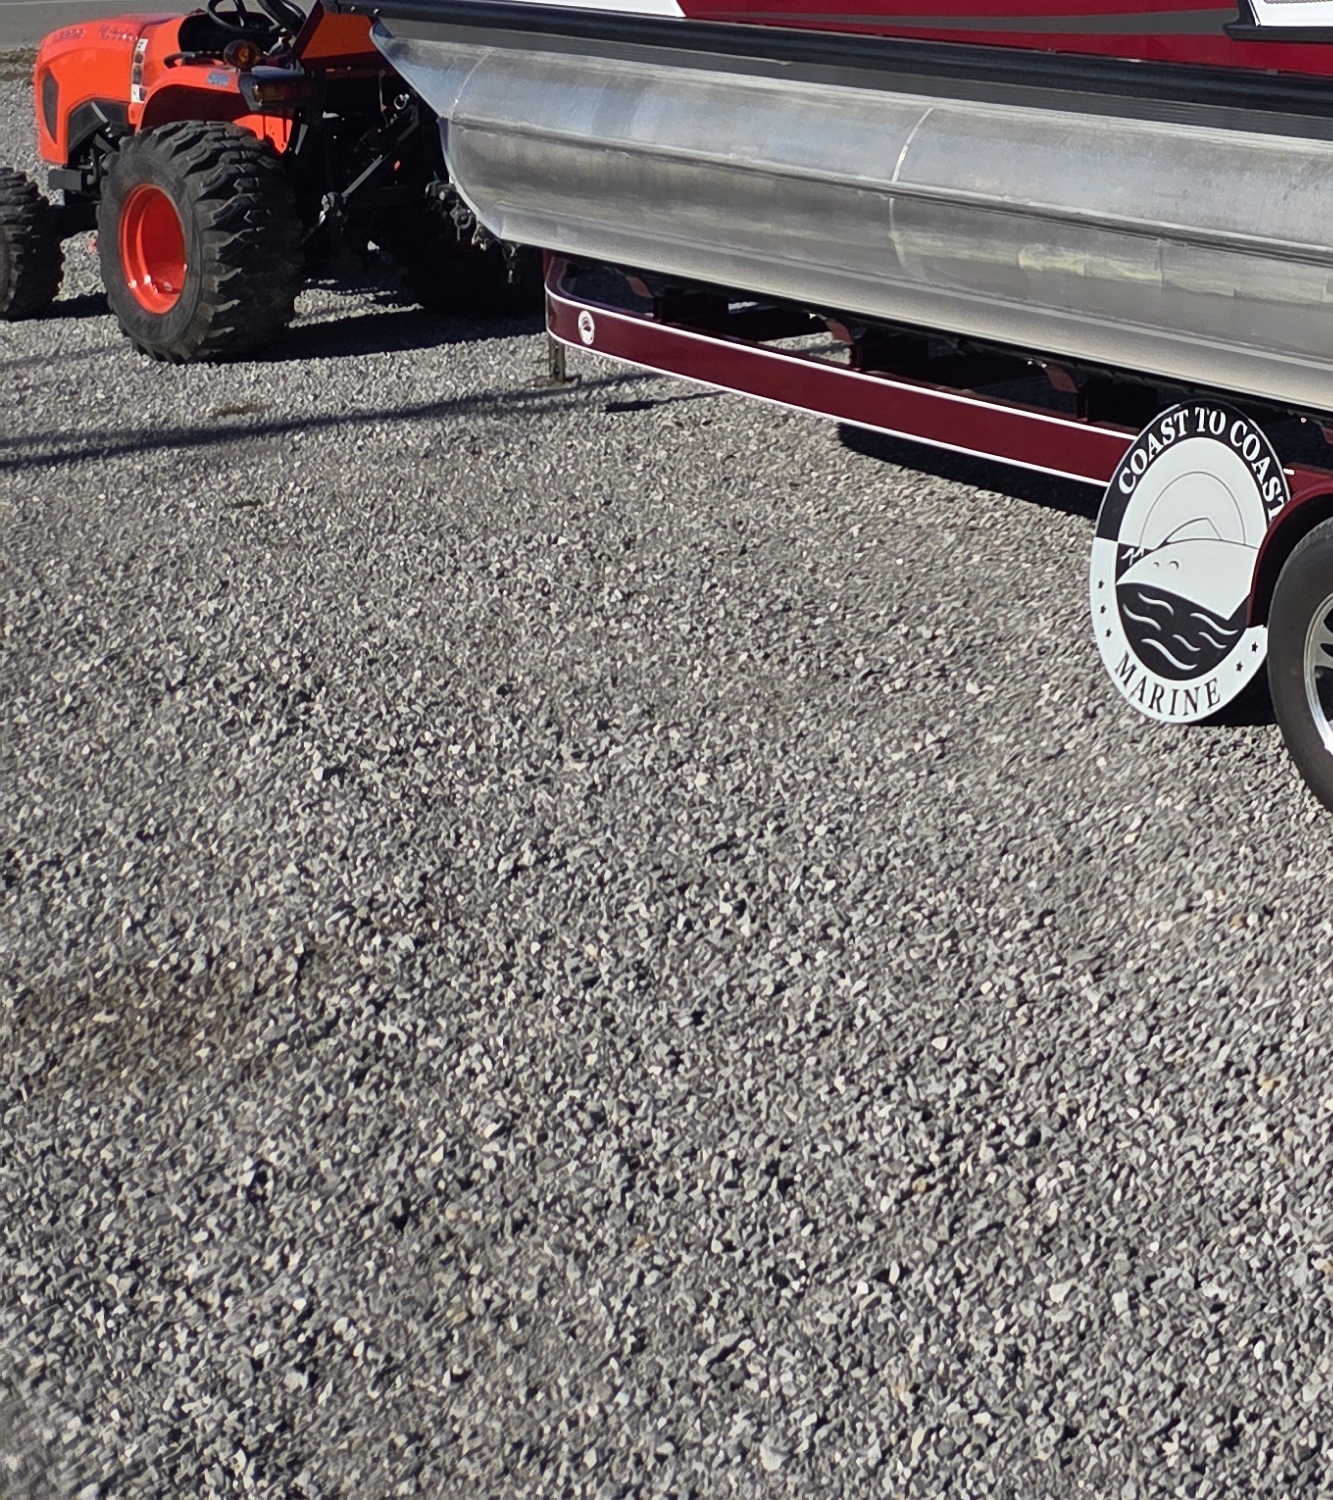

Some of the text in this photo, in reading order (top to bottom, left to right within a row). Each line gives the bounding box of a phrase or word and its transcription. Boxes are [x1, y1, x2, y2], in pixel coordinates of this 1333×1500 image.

[1118, 406, 1285, 523] COAST TO COAST
[1114, 649, 1221, 717] MARINE
